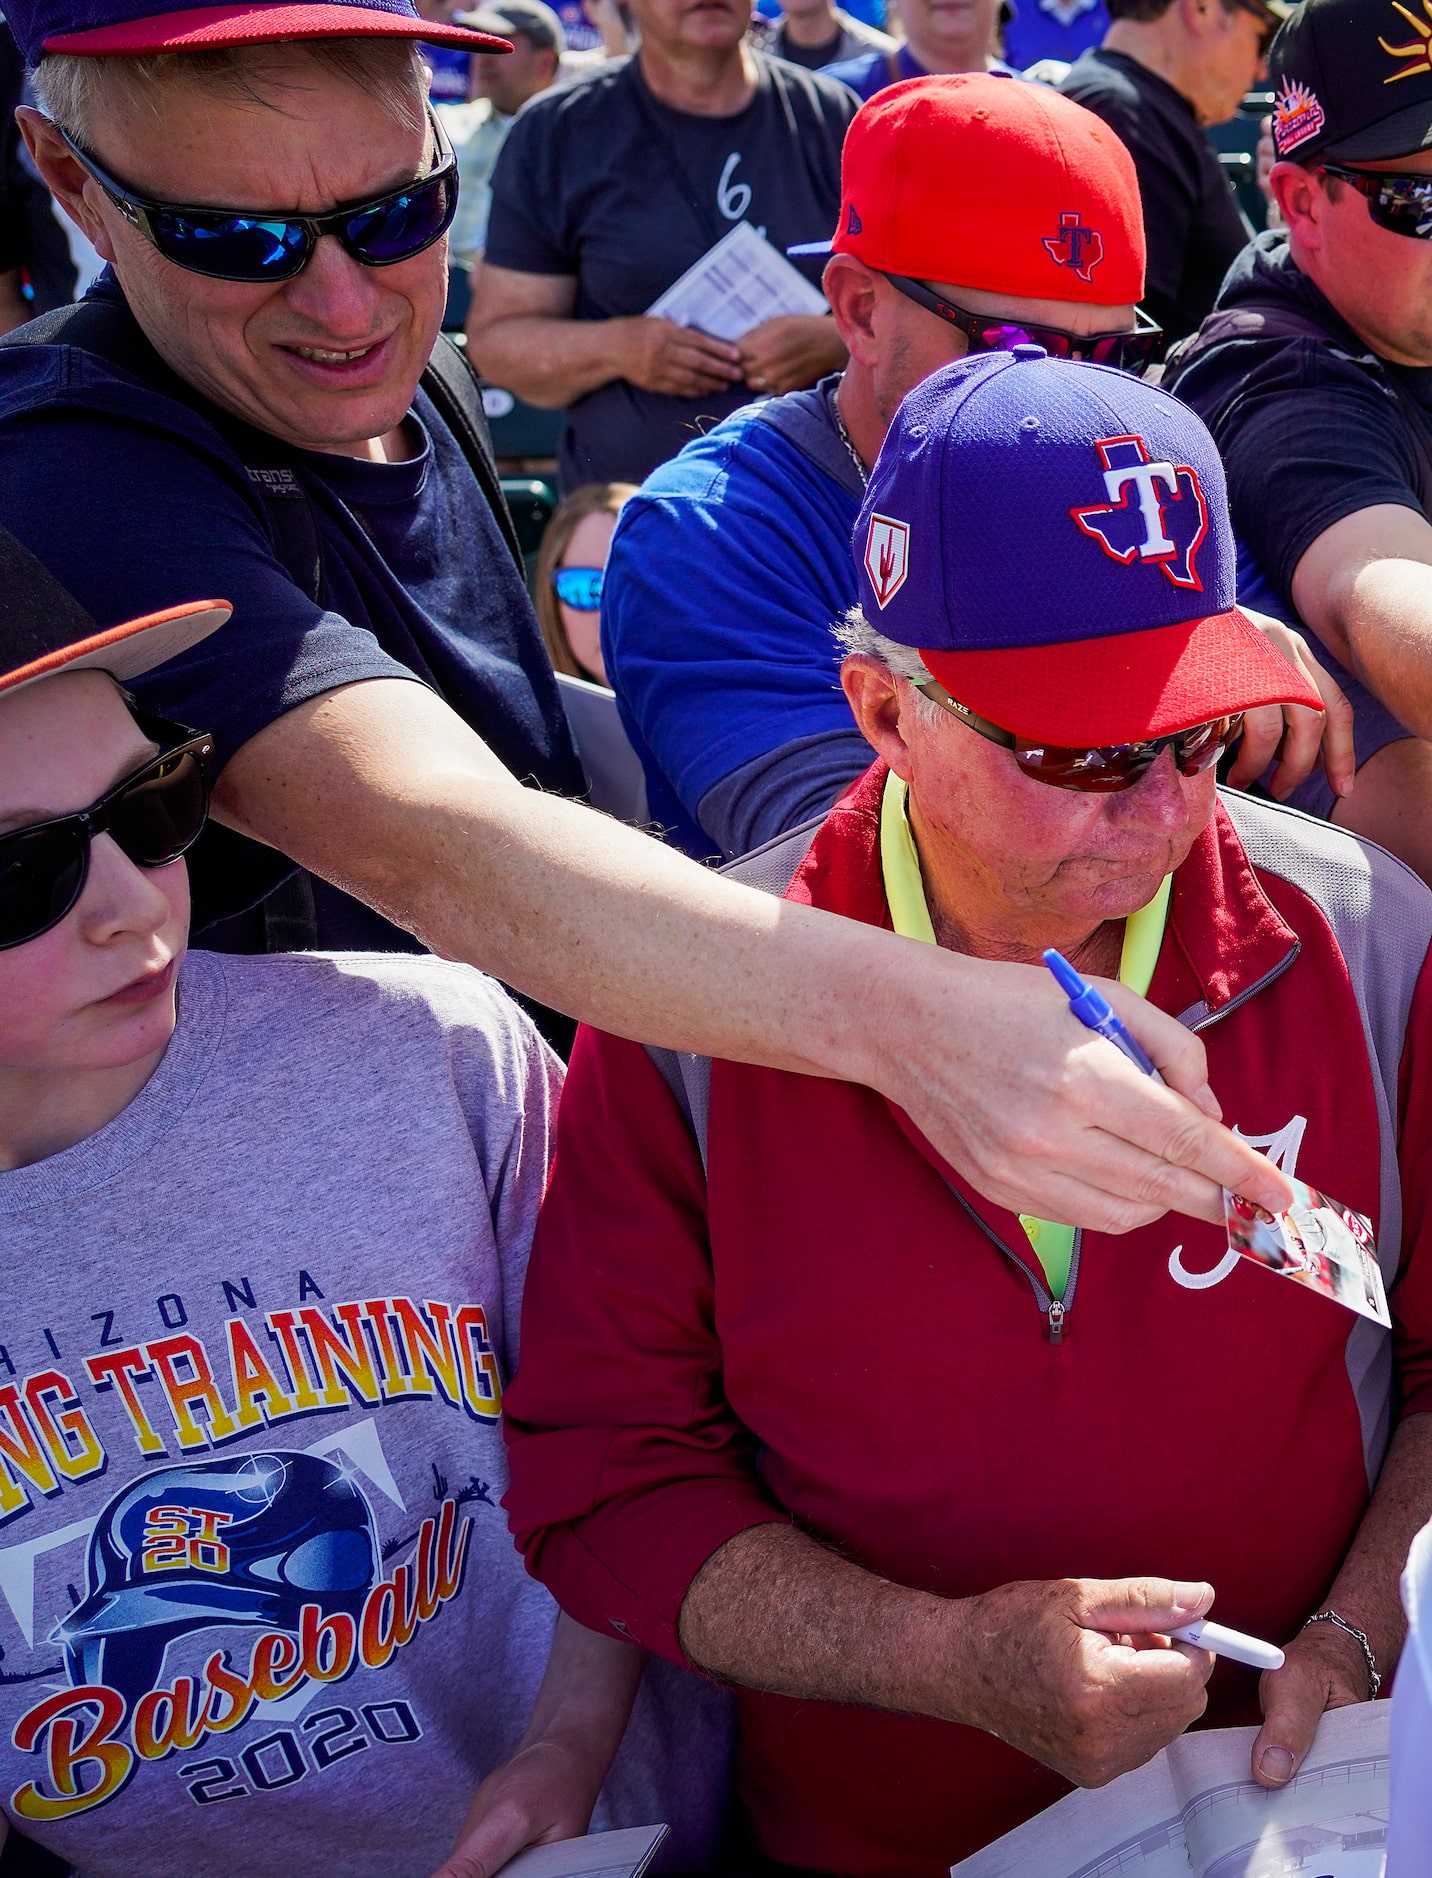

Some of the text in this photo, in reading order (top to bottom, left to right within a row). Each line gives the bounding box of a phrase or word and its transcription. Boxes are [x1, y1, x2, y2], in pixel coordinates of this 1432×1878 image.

[717, 152, 752, 221] 6
[1059, 227, 1092, 268] T
[1103, 461, 1183, 563] T
[947, 697, 970, 716] RAZE
[82, 1296, 503, 1460] TRAINING
[143, 1505, 234, 1542] ST
[143, 1536, 231, 1575] 20
[12, 1500, 474, 1821] Baseball
[177, 1699, 424, 1806] 2020
